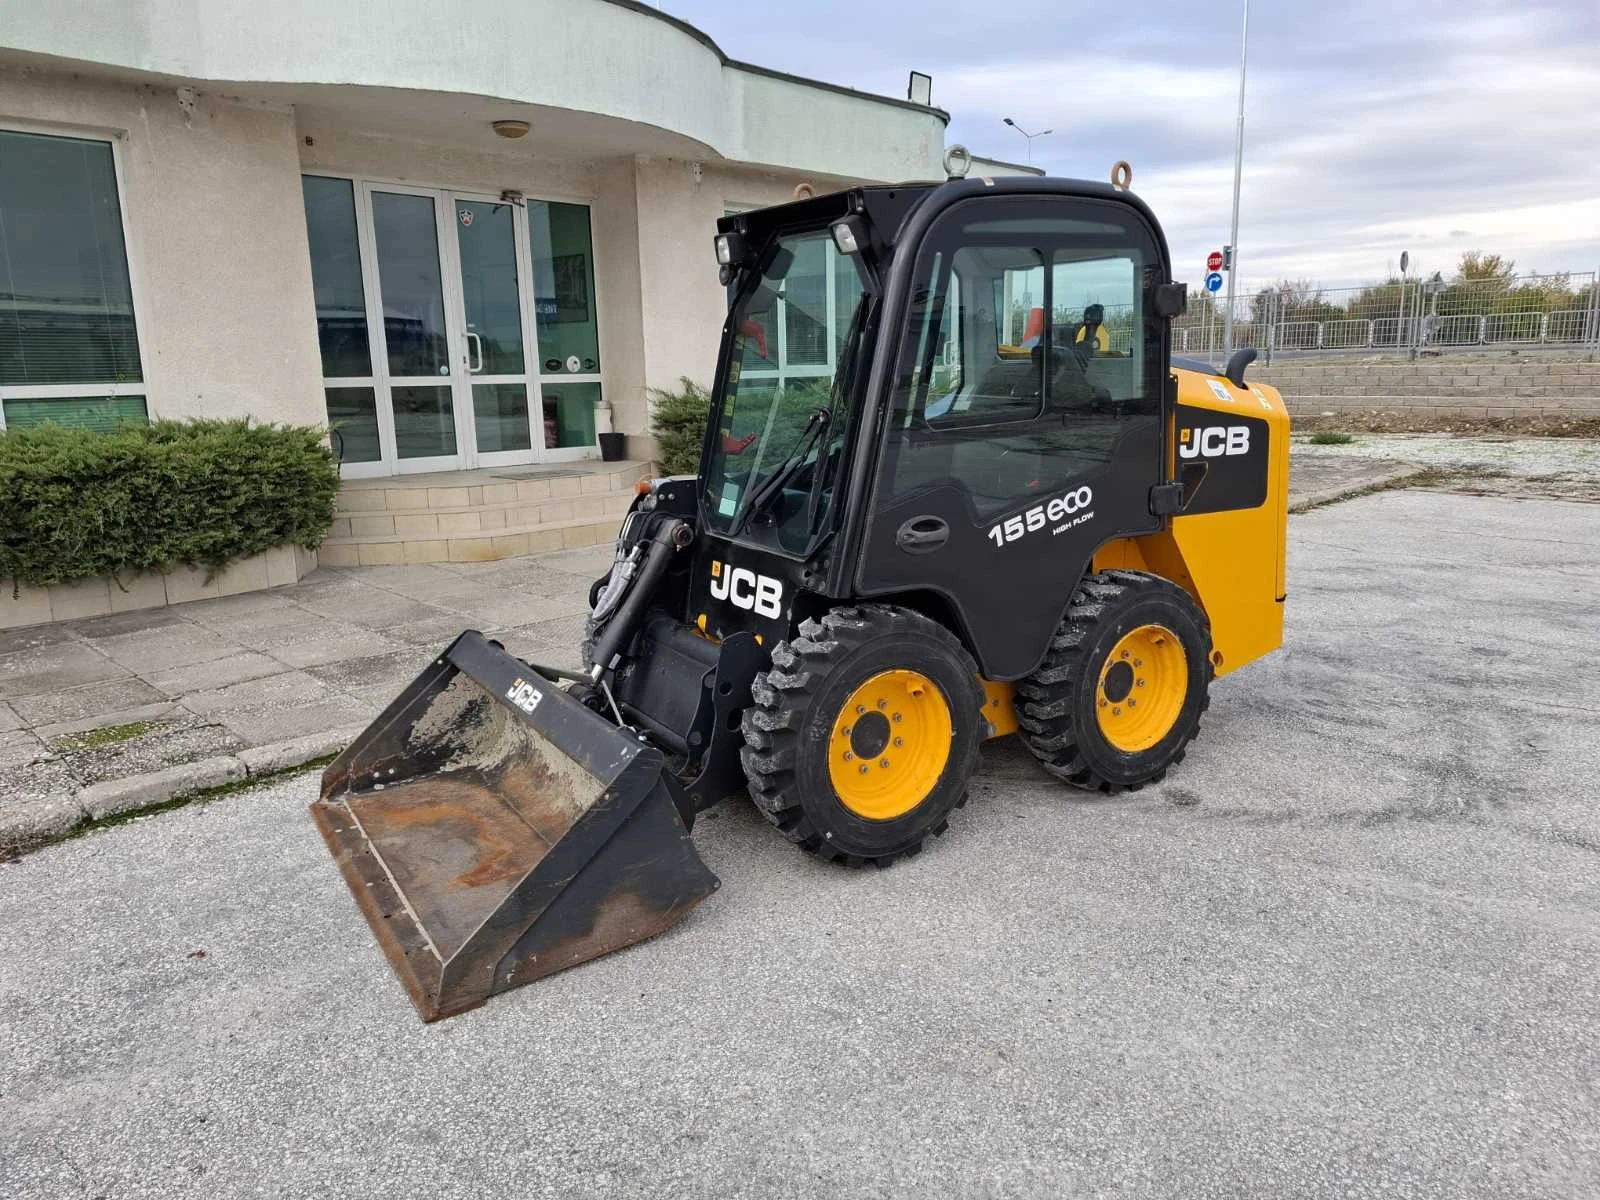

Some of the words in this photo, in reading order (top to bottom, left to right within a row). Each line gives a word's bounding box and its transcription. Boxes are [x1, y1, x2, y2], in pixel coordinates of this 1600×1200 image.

[1208, 257, 1222, 265] STOP
[1179, 426, 1250, 459] JCB
[1052, 522, 1071, 536] HIGH
[1073, 511, 1094, 525] FLOW
[710, 563, 783, 620] JCB
[505, 679, 543, 715] JCB
